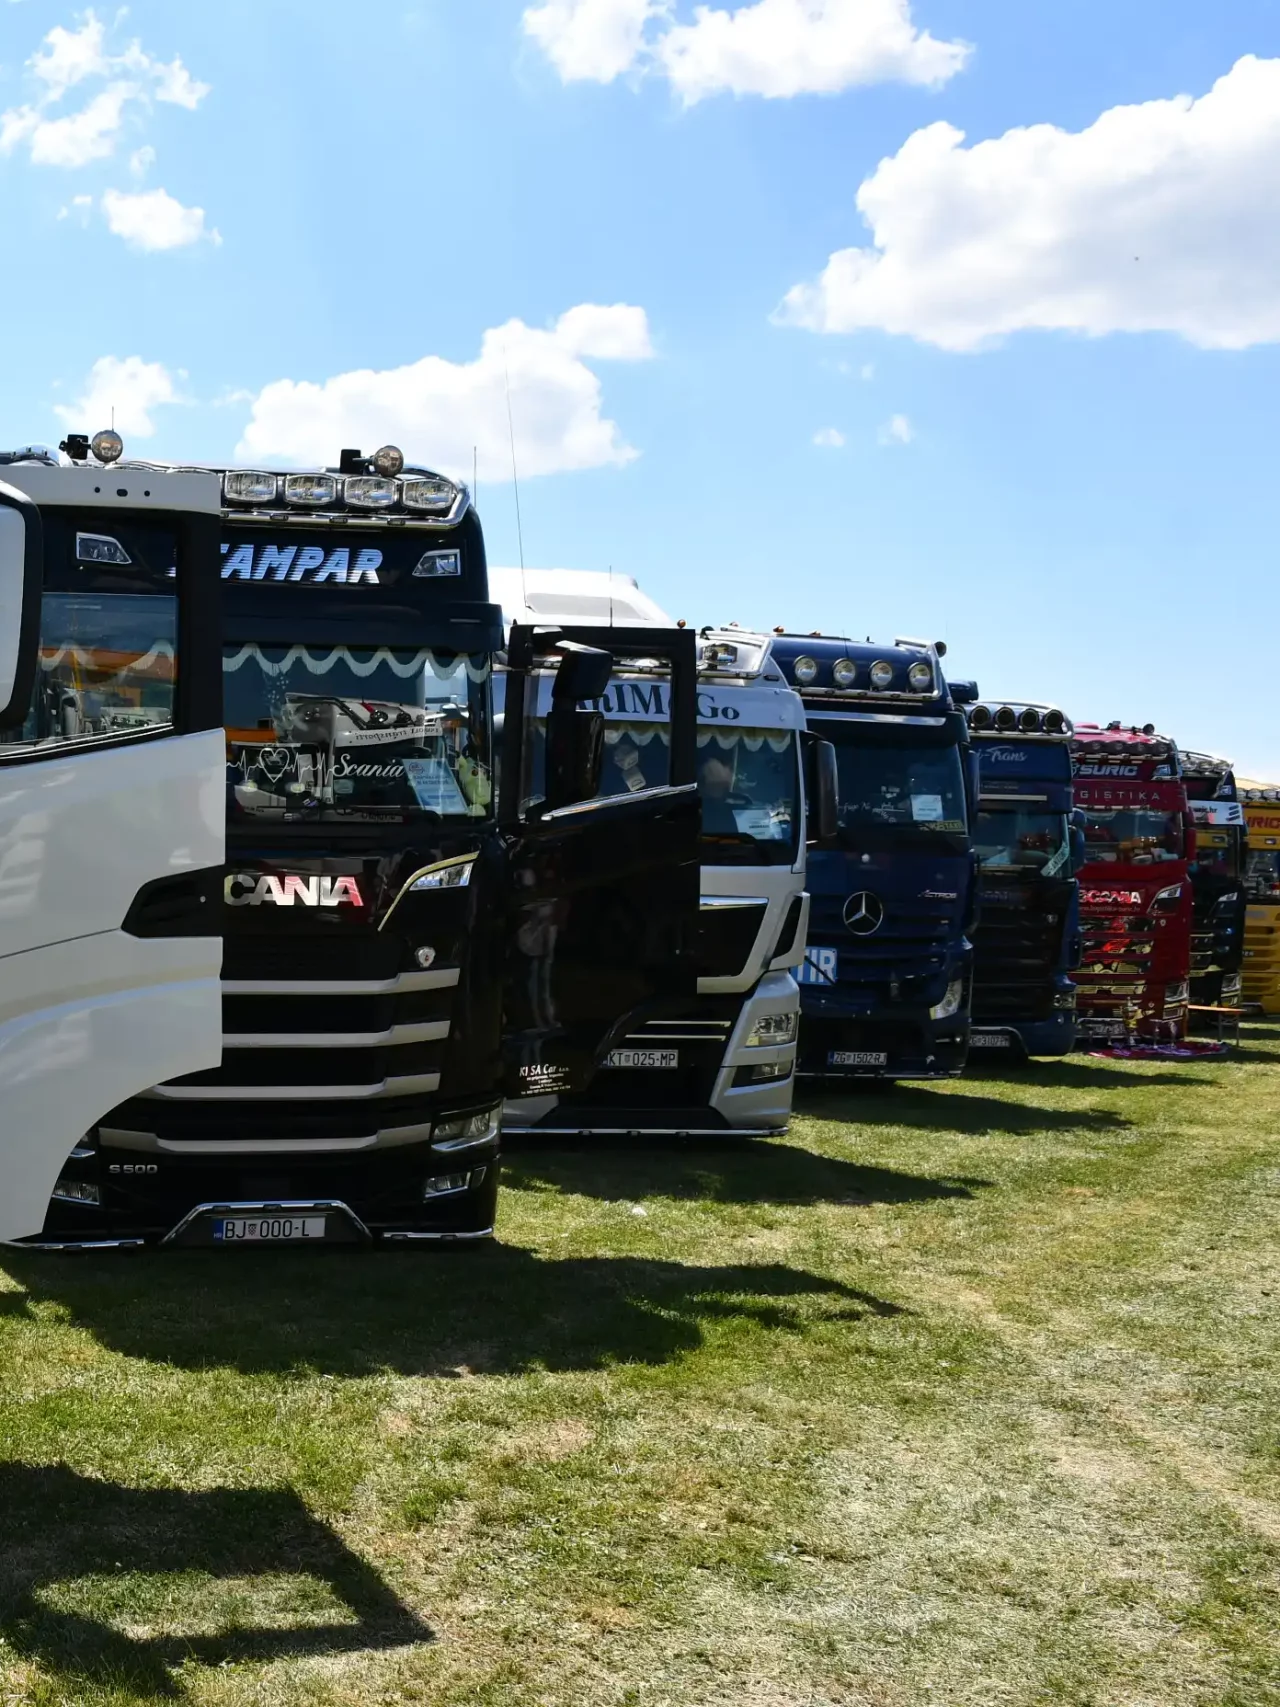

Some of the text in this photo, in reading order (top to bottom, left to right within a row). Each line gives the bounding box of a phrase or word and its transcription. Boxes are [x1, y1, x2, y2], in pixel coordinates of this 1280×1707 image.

[220, 543, 383, 584] AMPAR
[333, 753, 406, 778] Scania
[1079, 764, 1138, 777] SURIC
[1078, 789, 1160, 801] GISTIKA
[223, 873, 365, 907] CANIA
[632, 1052, 676, 1066] 025-MP
[224, 1219, 310, 1239] BJ 000-L
